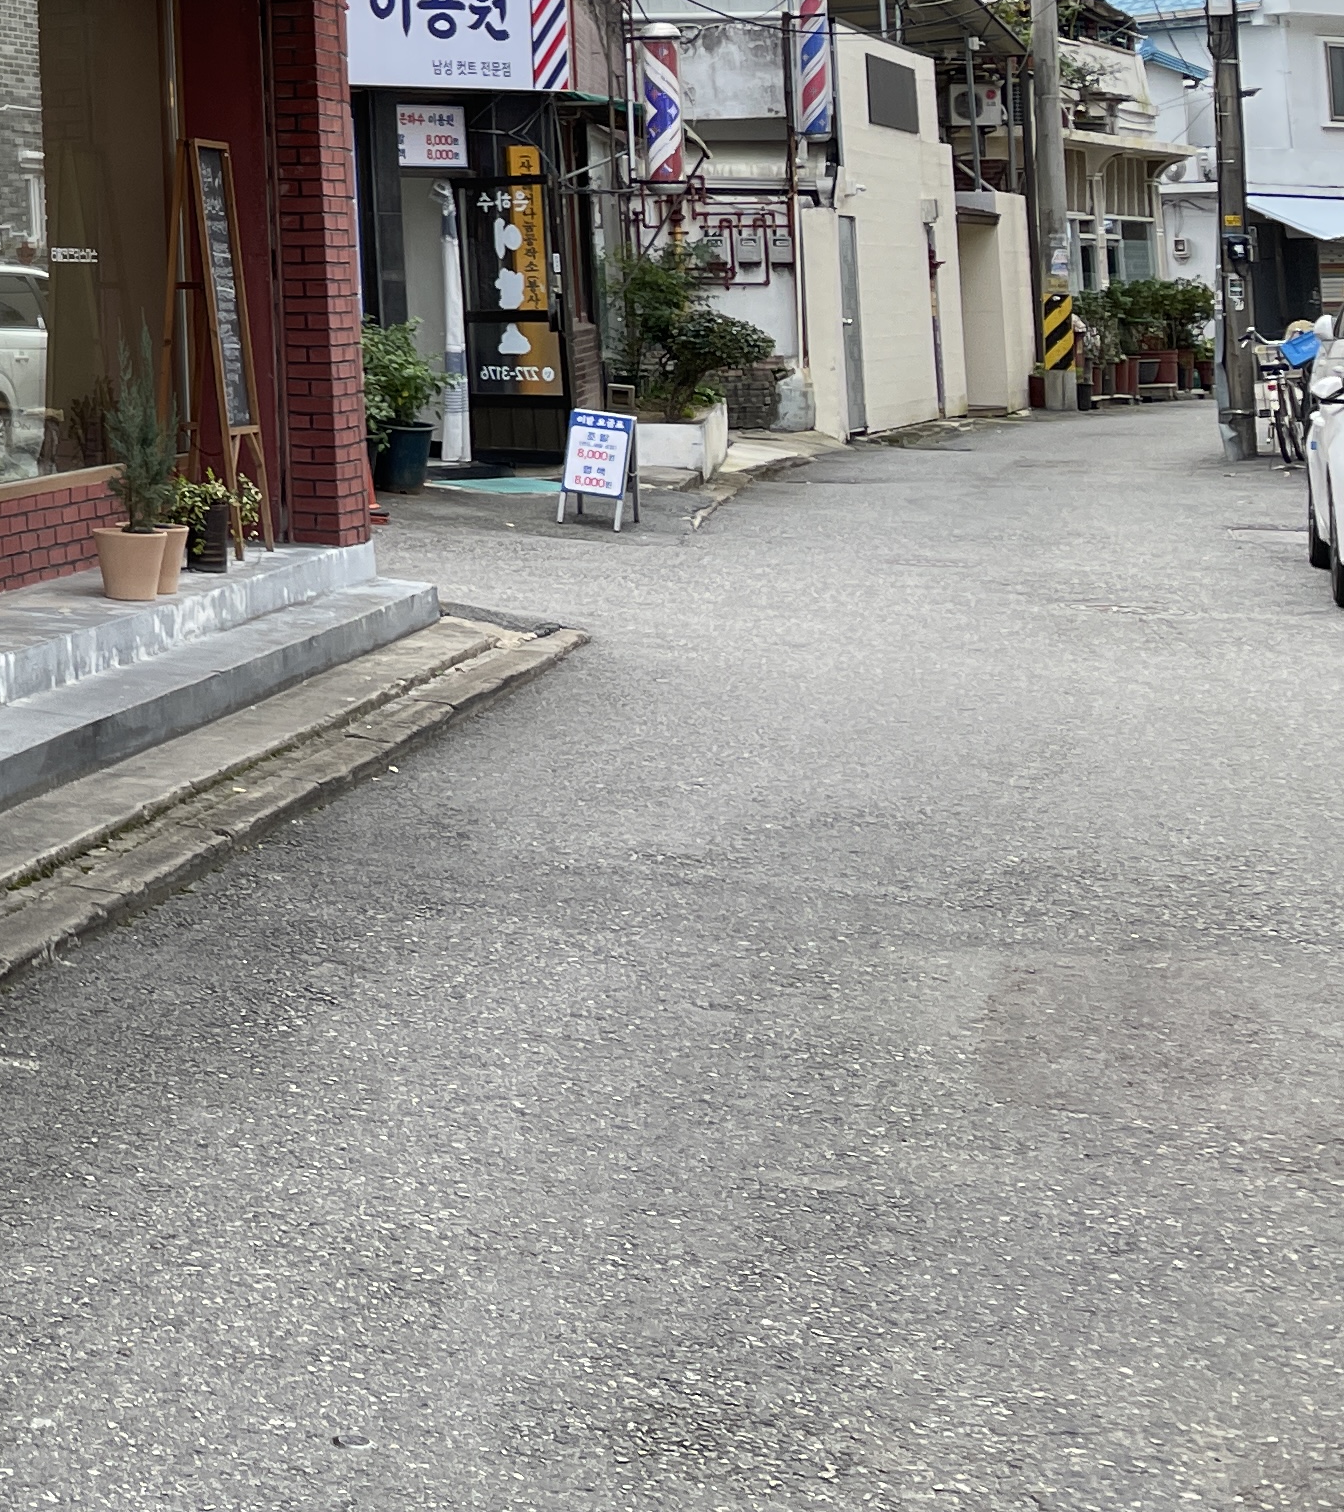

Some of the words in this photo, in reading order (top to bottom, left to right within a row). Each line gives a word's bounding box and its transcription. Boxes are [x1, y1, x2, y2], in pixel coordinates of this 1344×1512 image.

[431, 59, 453, 76] 남성
[480, 61, 512, 78] 전문점
[427, 113, 455, 127] 이용원
